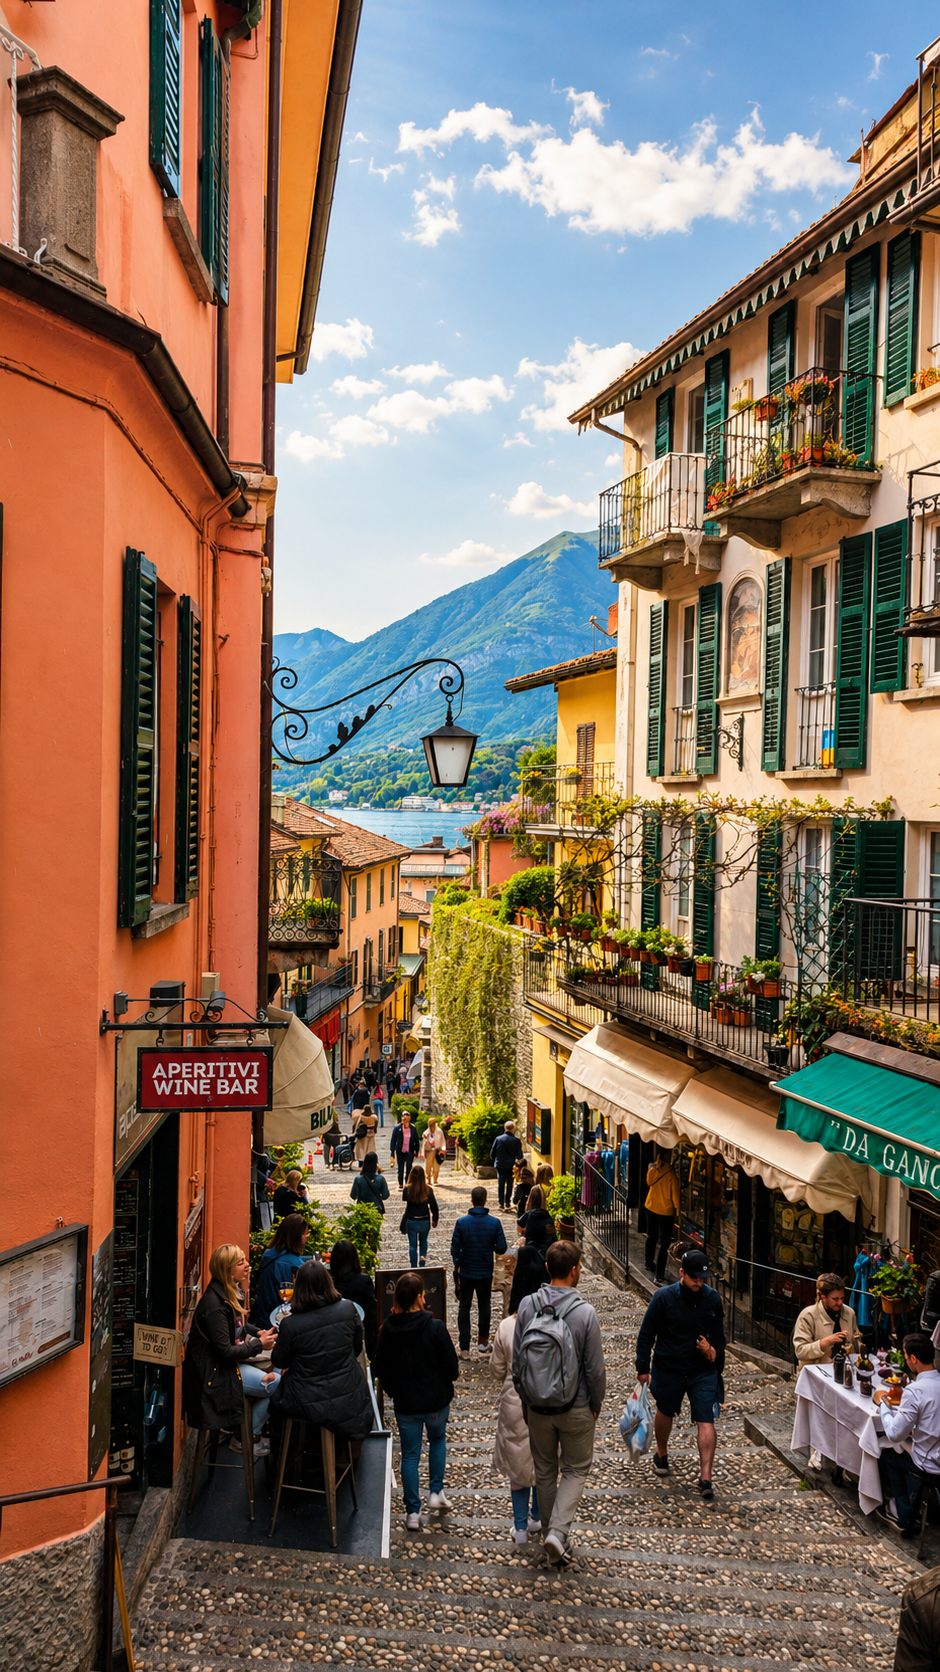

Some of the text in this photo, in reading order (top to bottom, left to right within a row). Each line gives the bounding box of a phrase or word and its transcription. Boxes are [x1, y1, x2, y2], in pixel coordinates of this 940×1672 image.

[152, 1062, 259, 1079] APERITIVI
[153, 1079, 258, 1095] WINE BAR
